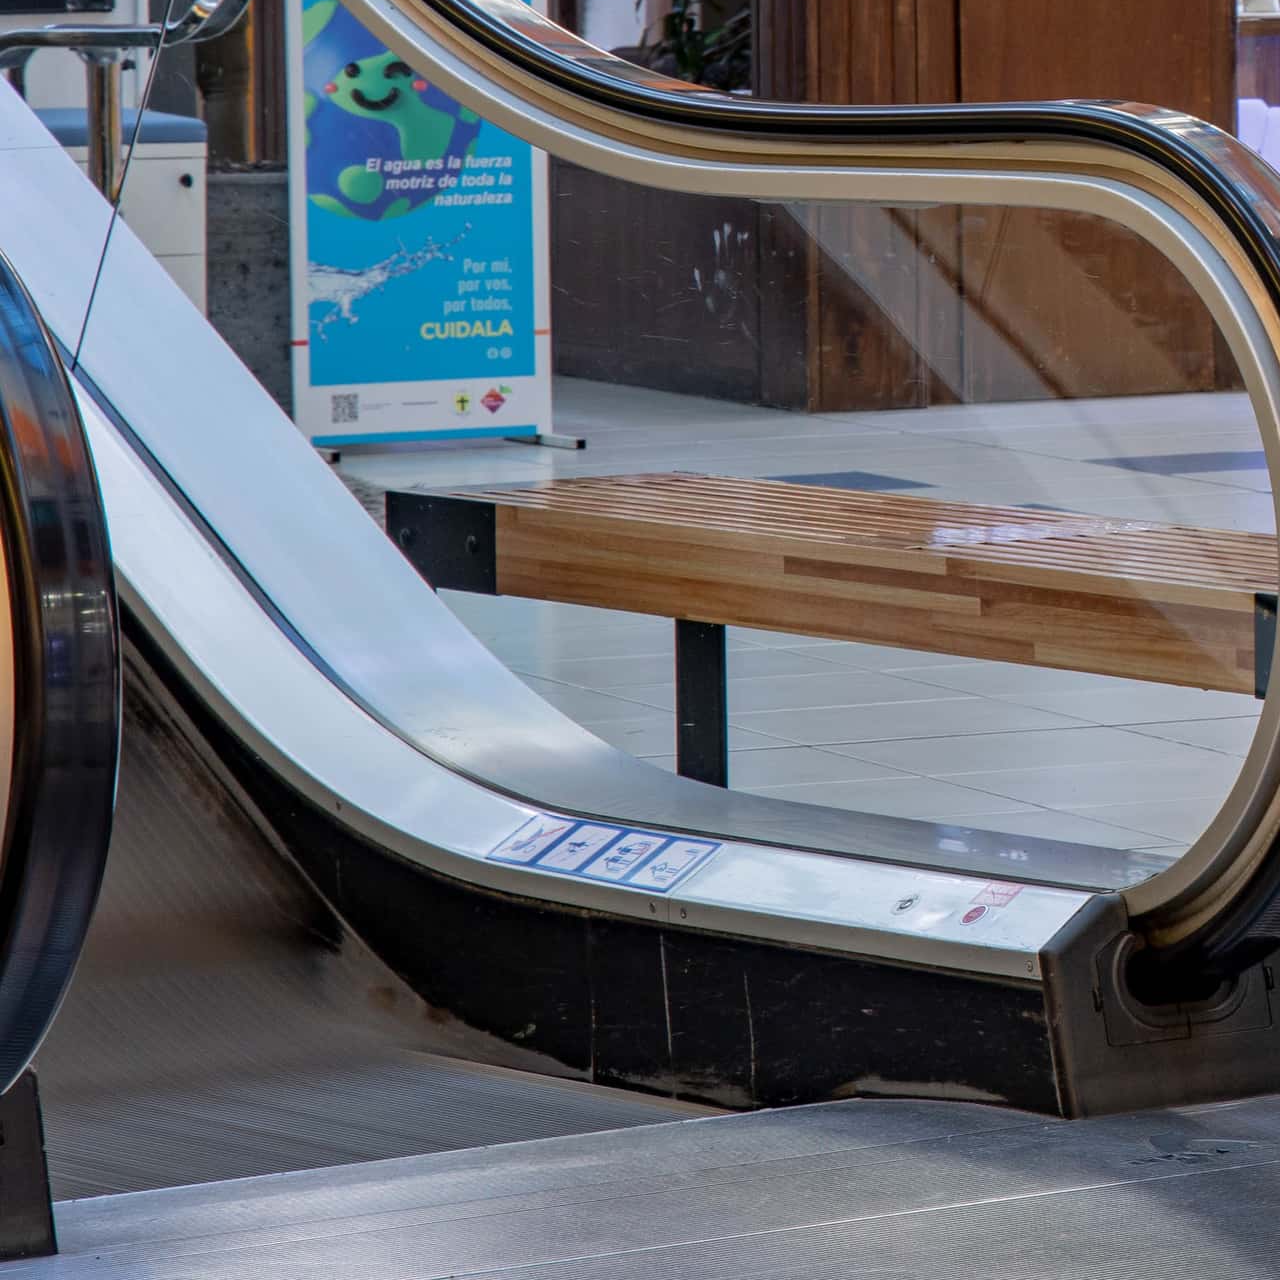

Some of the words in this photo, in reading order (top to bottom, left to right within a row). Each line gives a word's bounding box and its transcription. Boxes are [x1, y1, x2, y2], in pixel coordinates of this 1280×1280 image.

[366, 157, 382, 172] El
[384, 158, 423, 174] agua
[425, 159, 444, 171] es
[447, 155, 462, 169] la
[465, 155, 512, 169] fuerza
[385, 175, 434, 190] motriz
[438, 174, 457, 188] de
[461, 173, 495, 188] toda
[498, 172, 512, 186] la
[434, 192, 512, 206] naturaleza
[463, 258, 486, 274] Por
[458, 279, 480, 296] por
[443, 299, 466, 316] por
[421, 319, 514, 340] CUIDALA
